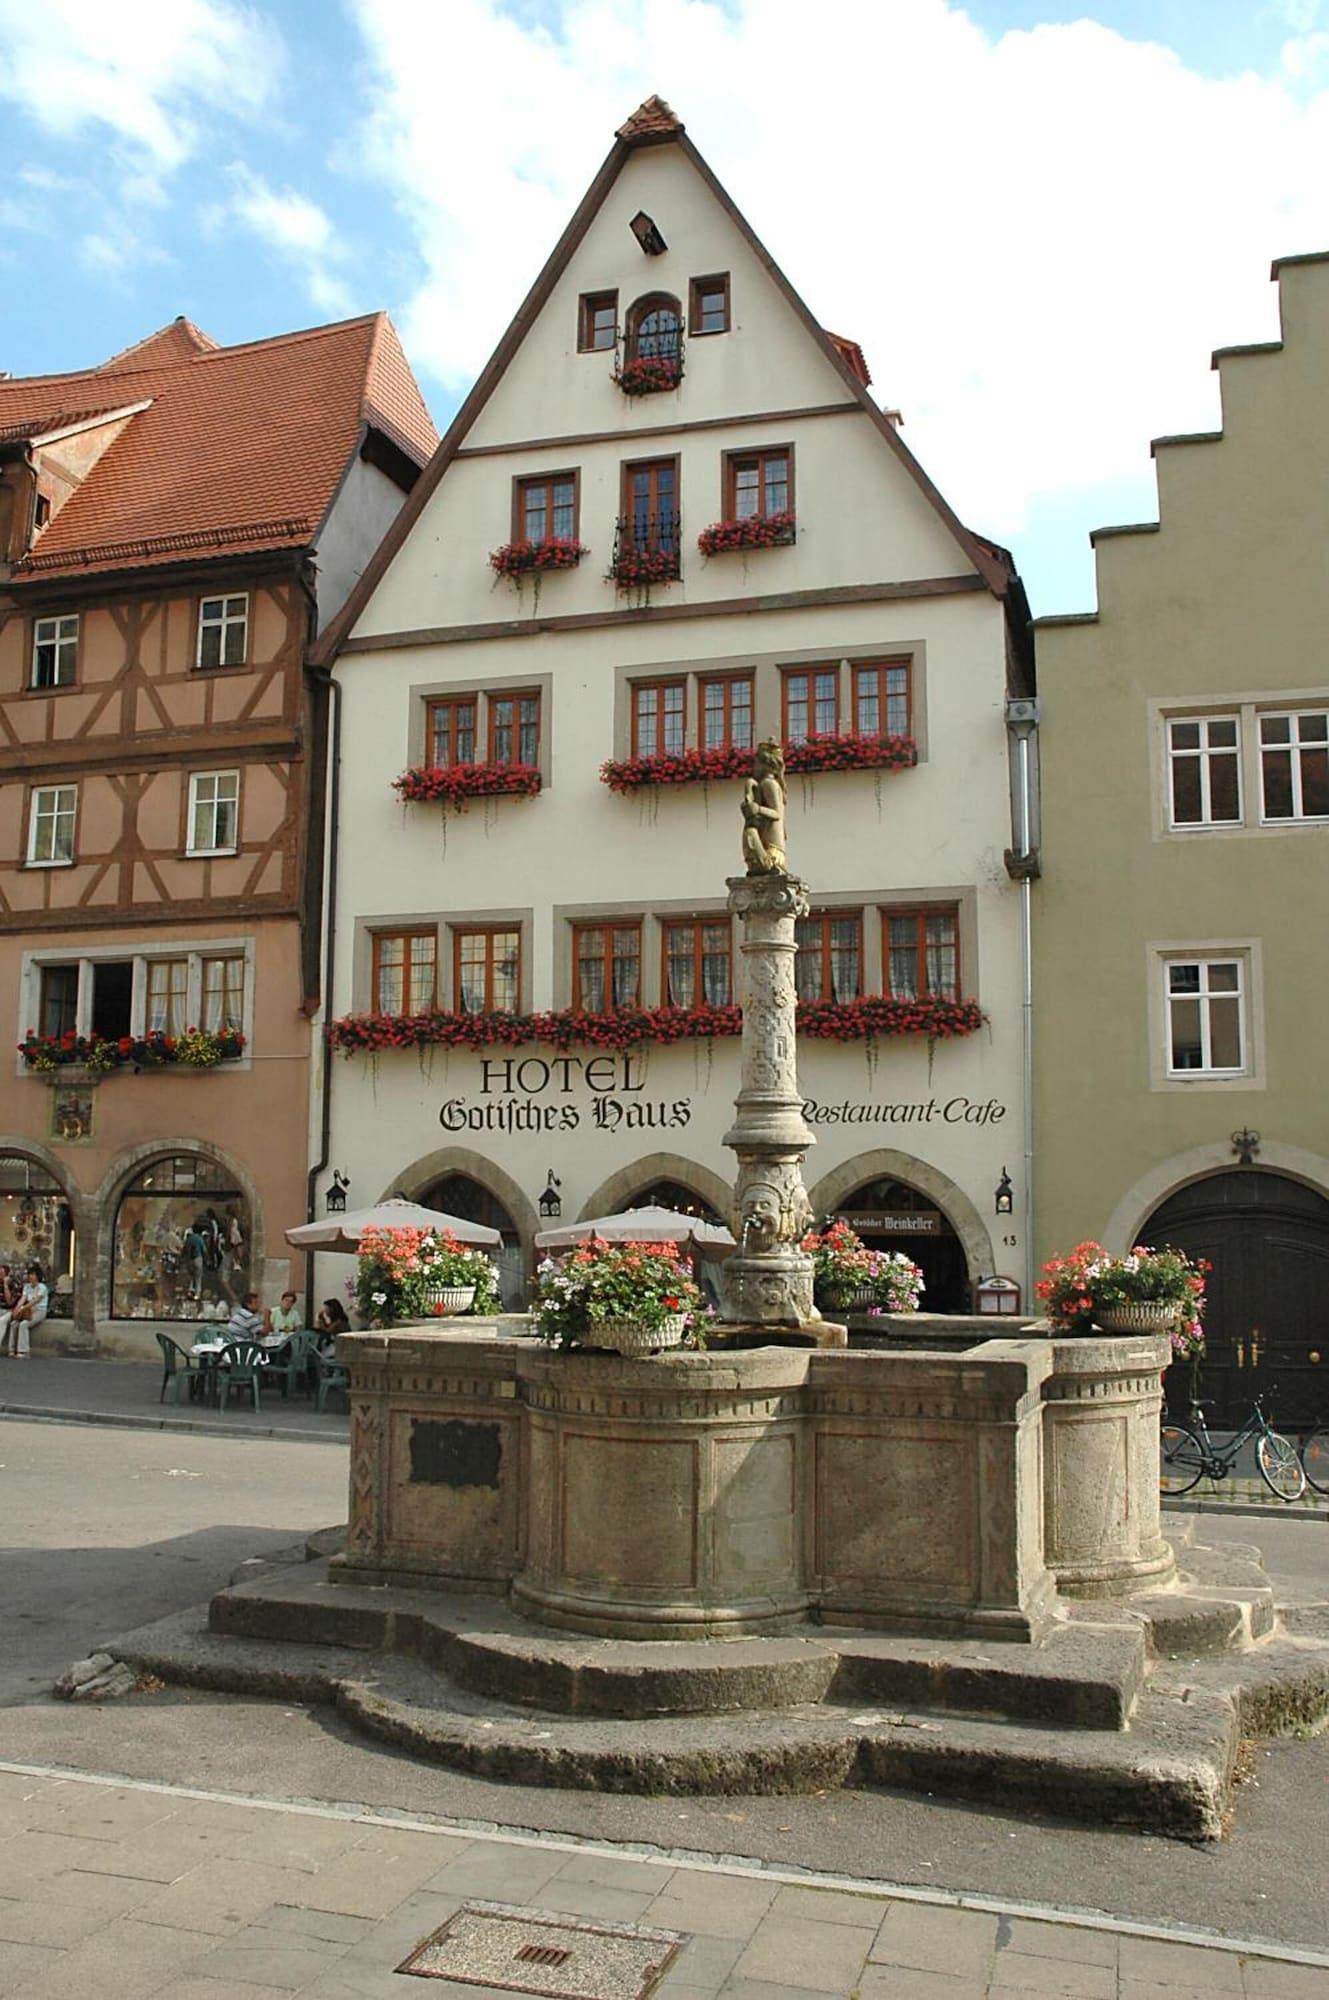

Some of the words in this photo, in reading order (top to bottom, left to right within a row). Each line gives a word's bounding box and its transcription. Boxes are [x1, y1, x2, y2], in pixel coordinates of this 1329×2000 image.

[479, 1056, 646, 1094] HOTEL
[591, 1094, 692, 1133] Haus
[884, 1216, 933, 1230] Weinkeller
